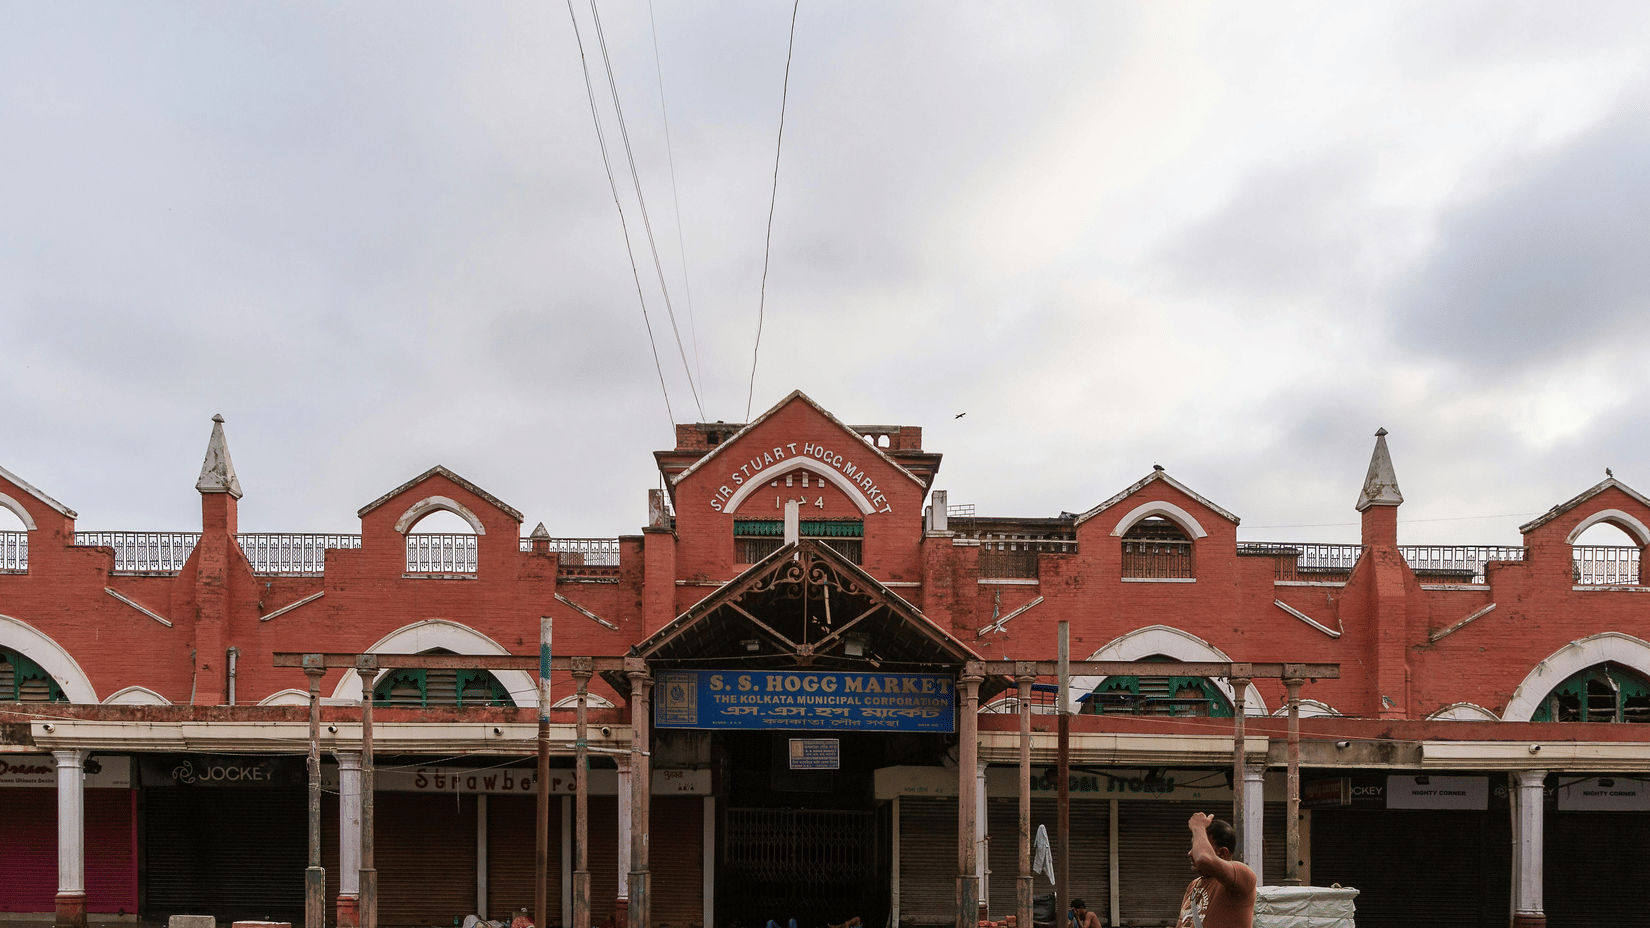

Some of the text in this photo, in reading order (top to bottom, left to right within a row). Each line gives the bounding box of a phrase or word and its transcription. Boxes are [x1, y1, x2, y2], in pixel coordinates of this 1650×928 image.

[710, 442, 892, 515] SIR STUART HOGG MARKET
[709, 674, 952, 694] S. S. HOGG MARKET
[713, 694, 949, 707] THE KOLKATA MUNICIPAL CORPORATION
[762, 718, 825, 727] কলকাতা
[415, 768, 578, 791] Strawbery
